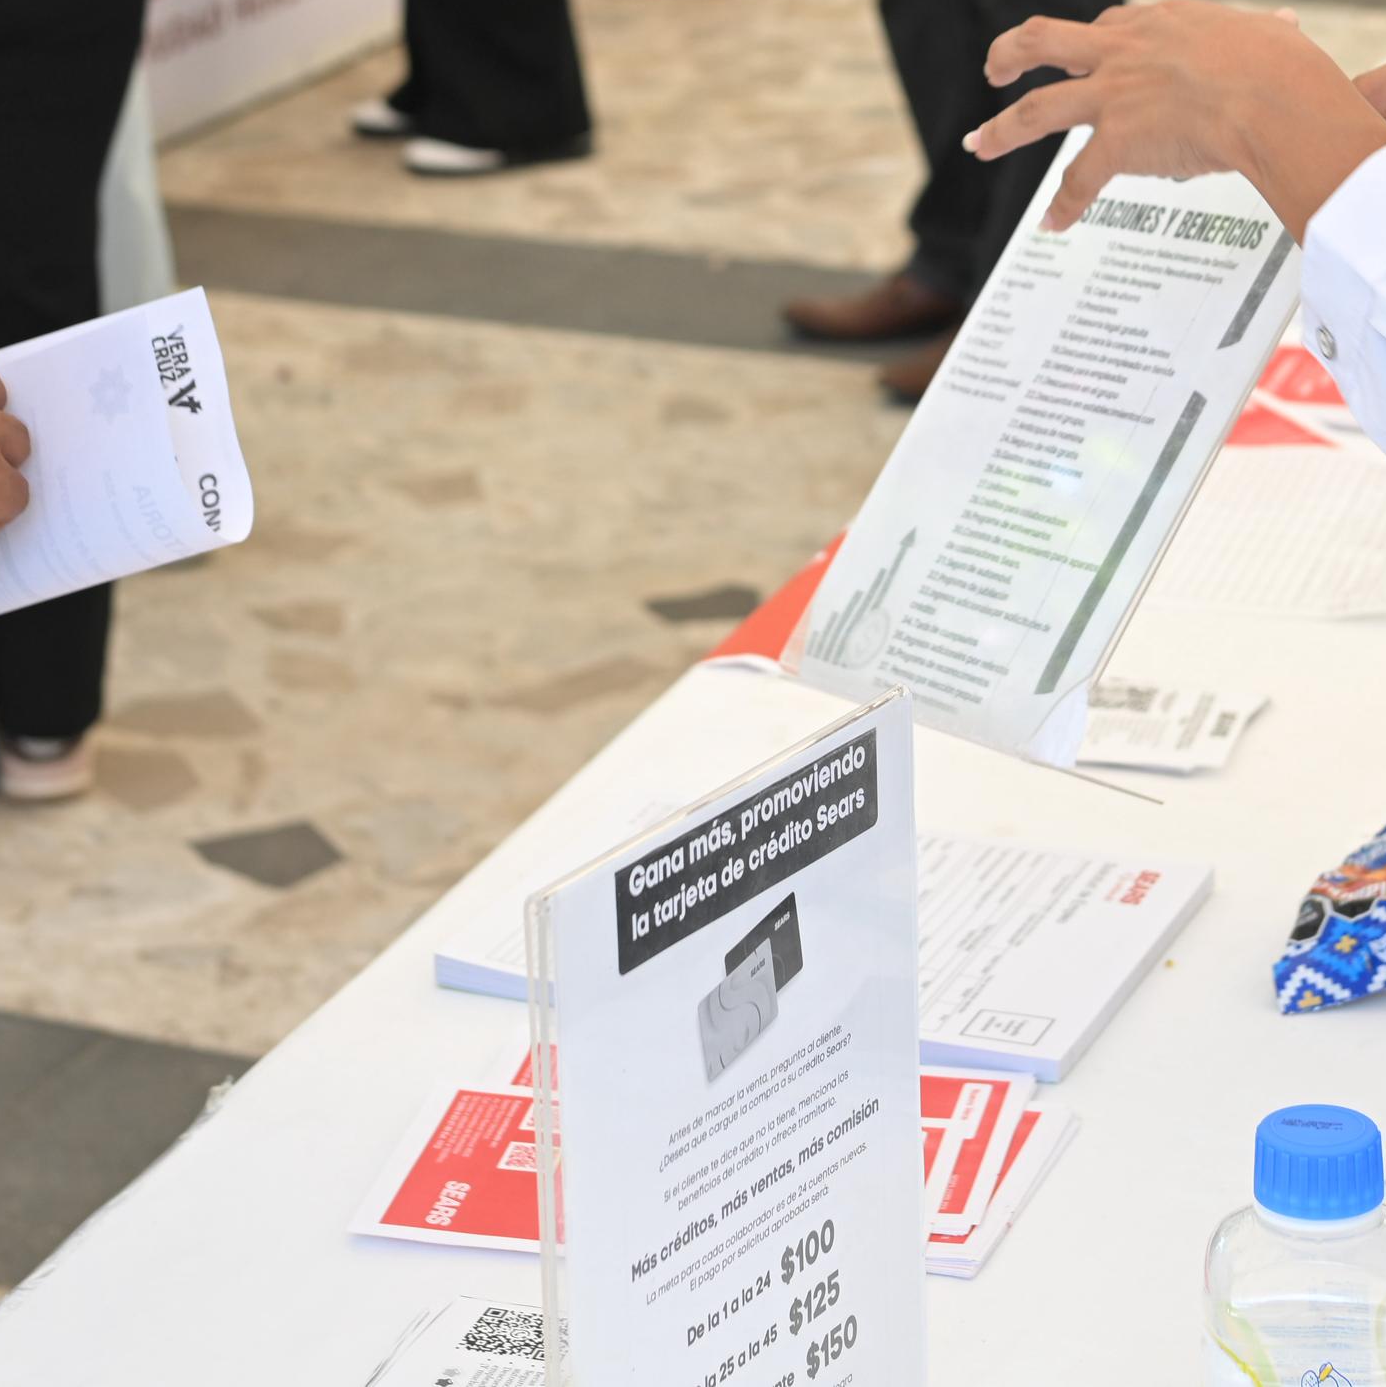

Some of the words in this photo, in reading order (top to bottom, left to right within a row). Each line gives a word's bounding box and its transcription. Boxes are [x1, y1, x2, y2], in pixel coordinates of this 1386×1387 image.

[1162, 208, 1181, 236] Y
[1173, 210, 1269, 250] BENEFICIOS
[166, 324, 192, 379] VERA
[199, 473, 221, 533] CON
[629, 847, 683, 897] Gana
[689, 819, 737, 864] más,
[741, 745, 865, 841] promoviendo
[632, 912, 649, 941] la
[653, 873, 717, 927] tarjeta
[721, 856, 744, 887] de
[748, 817, 813, 871] crédito
[816, 787, 865, 831] Sears
[659, 1143, 690, 1173] ¿Desea
[691, 1131, 707, 1151] que
[708, 1111, 739, 1140] cargue
[739, 1105, 748, 1118] la
[748, 1083, 780, 1112] compra
[780, 1079, 787, 1089] a
[787, 1072, 797, 1086] su
[798, 1051, 825, 1077] crédito
[826, 1033, 852, 1062] Sears?
[664, 1189, 671, 1204] Si
[672, 1184, 680, 1197] el
[681, 1164, 709, 1192] cliente
[710, 1159, 719, 1172] te
[720, 1144, 738, 1165] dice
[739, 1134, 755, 1153] que
[755, 1127, 766, 1141] no
[767, 1119, 775, 1133] la
[798, 1080, 837, 1112] menciona
[837, 1069, 849, 1086] los
[668, 1124, 691, 1146] Antes
[692, 1115, 703, 1130] de
[705, 1095, 735, 1123] marcar
[736, 1087, 744, 1100] la
[770, 1047, 806, 1080] pregunta
[806, 1042, 815, 1056] al
[425, 1180, 471, 1226] SEARS
[631, 1253, 658, 1282] Más
[660, 1211, 718, 1261] créditos,
[721, 1189, 748, 1220] más
[750, 1158, 796, 1199] ventas,
[798, 1134, 824, 1166] más
[826, 1097, 879, 1145] comisión
[677, 1174, 722, 1211] beneficios
[722, 1163, 734, 1181] del
[735, 1143, 764, 1171] crédito
[765, 1140, 770, 1153] y
[771, 1123, 797, 1147] ofrece
[646, 1290, 657, 1306] La
[658, 1274, 680, 1297] meta
[680, 1259, 701, 1285] para
[701, 1244, 724, 1266] cada
[725, 1209, 775, 1252] colaborador
[776, 1200, 786, 1212] es
[786, 1190, 797, 1206] de
[798, 1183, 808, 1198] 24
[808, 1162, 839, 1190] cuentas
[686, 1320, 705, 1347] De
[707, 1310, 720, 1331] la
[723, 1302, 729, 1320] 1
[731, 1297, 739, 1313] a
[741, 1286, 753, 1303] la
[755, 1270, 772, 1296] 24
[780, 1218, 835, 1285] $100
[690, 1278, 697, 1292] El
[697, 1264, 721, 1289] pago
[722, 1254, 736, 1273] por
[737, 1229, 770, 1259] solicitud
[771, 1199, 811, 1237] aprobada
[719, 1356, 735, 1383] 25
[737, 1353, 746, 1368] a
[748, 1340, 760, 1361] la
[763, 1323, 778, 1353] 45
[789, 1268, 840, 1336] $125
[806, 1315, 858, 1380] $150
